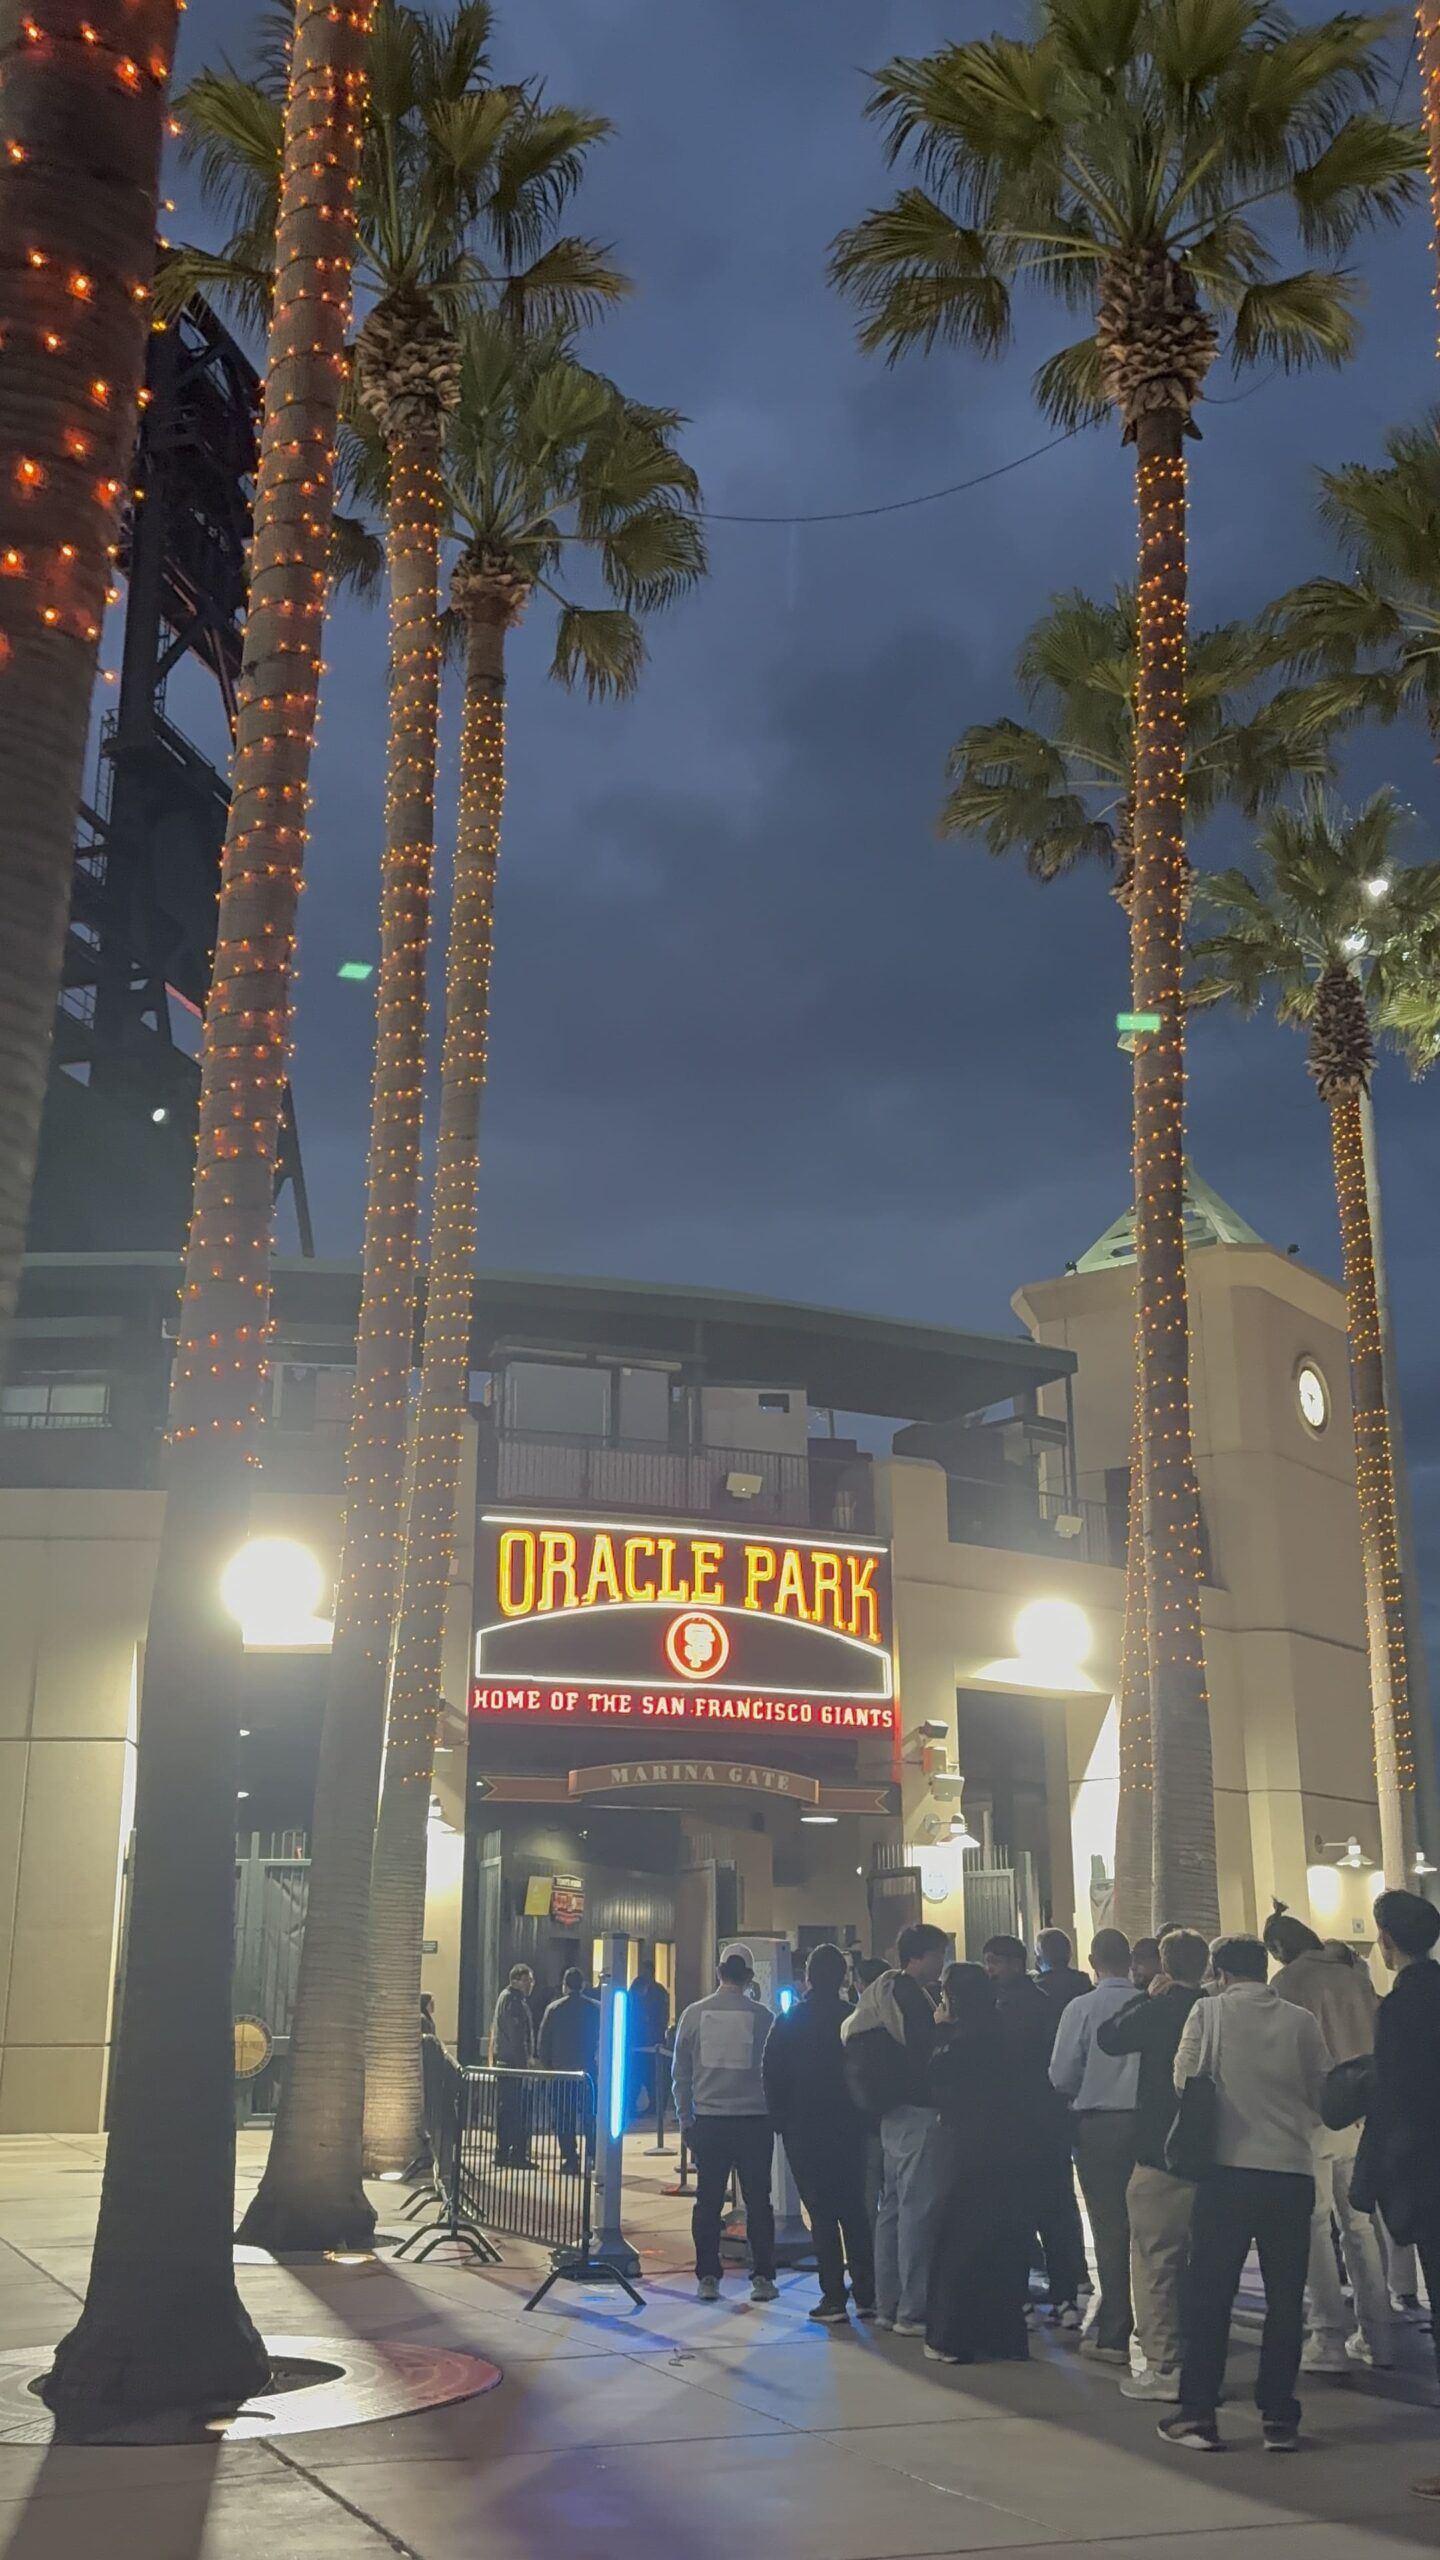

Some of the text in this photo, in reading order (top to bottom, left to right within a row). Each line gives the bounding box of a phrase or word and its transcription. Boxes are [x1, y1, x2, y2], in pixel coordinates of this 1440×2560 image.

[500, 1529, 881, 1643] ORACLE PARK
[474, 1688, 893, 1728] HOME OF THE SAN FRANCISCO GIANTS
[611, 1764, 790, 1791] MARINA GATE
